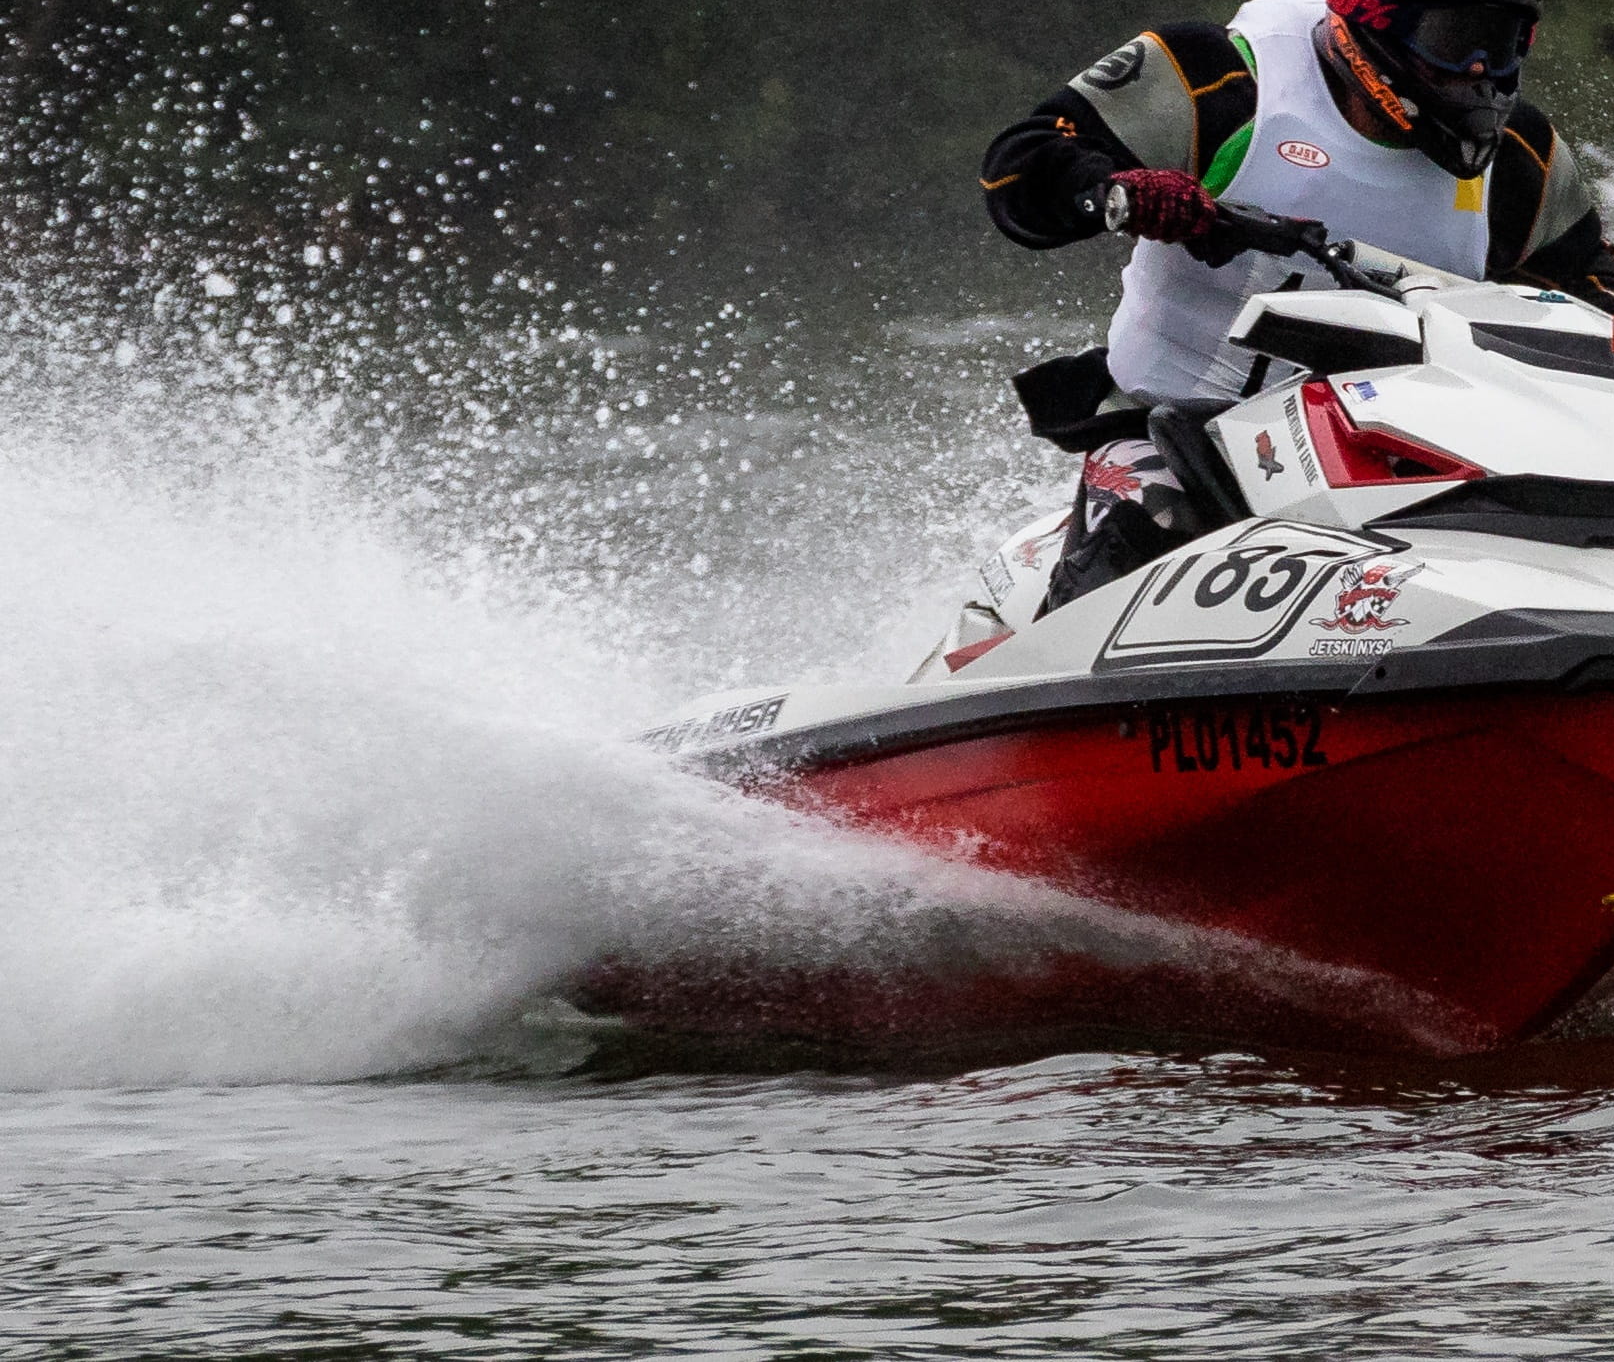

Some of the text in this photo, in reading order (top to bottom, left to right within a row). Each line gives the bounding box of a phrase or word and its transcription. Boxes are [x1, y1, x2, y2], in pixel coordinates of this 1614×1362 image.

[1153, 545, 1348, 612] 185
[1310, 639, 1393, 656] JETSKI NYSA
